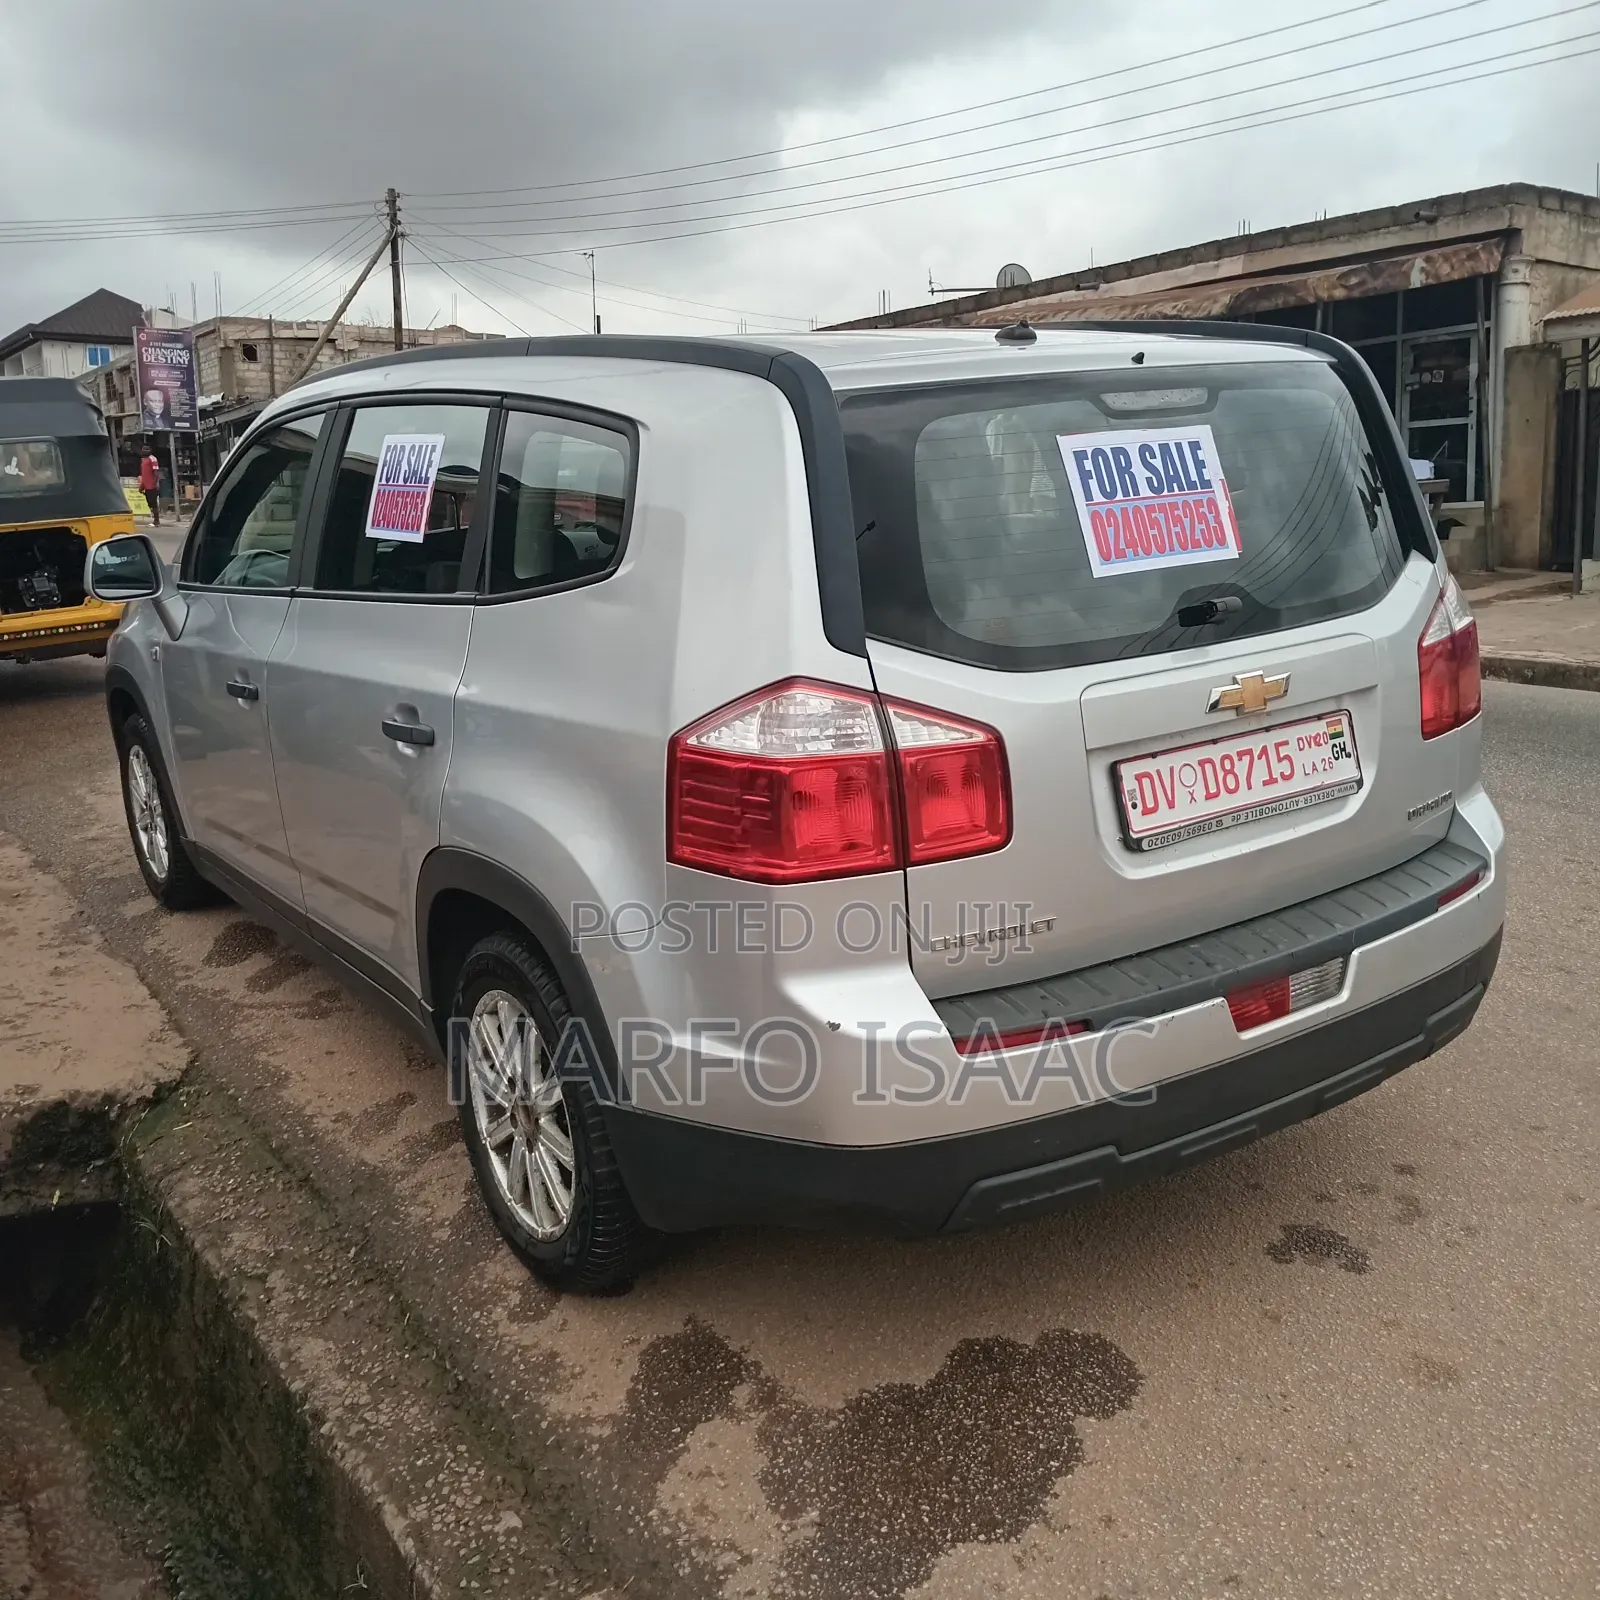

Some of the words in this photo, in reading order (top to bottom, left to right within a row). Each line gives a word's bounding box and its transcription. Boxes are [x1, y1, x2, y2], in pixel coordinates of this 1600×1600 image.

[141, 346, 190, 357] CHANGING
[142, 353, 190, 365] DESTINY
[379, 444, 405, 483] FOR
[403, 444, 438, 485] SALE
[1072, 446, 1140, 502] FOR
[1138, 441, 1212, 496] SALE
[1090, 497, 1227, 562] 0240575253
[1134, 765, 1175, 816] DV
[1198, 739, 1296, 801] D8715
[1231, 784, 1355, 822] www.DREXLER-AUTOMOBILE.de
[1147, 820, 1213, 848] 03695/603020
[931, 915, 1058, 952] CHEVROLET
